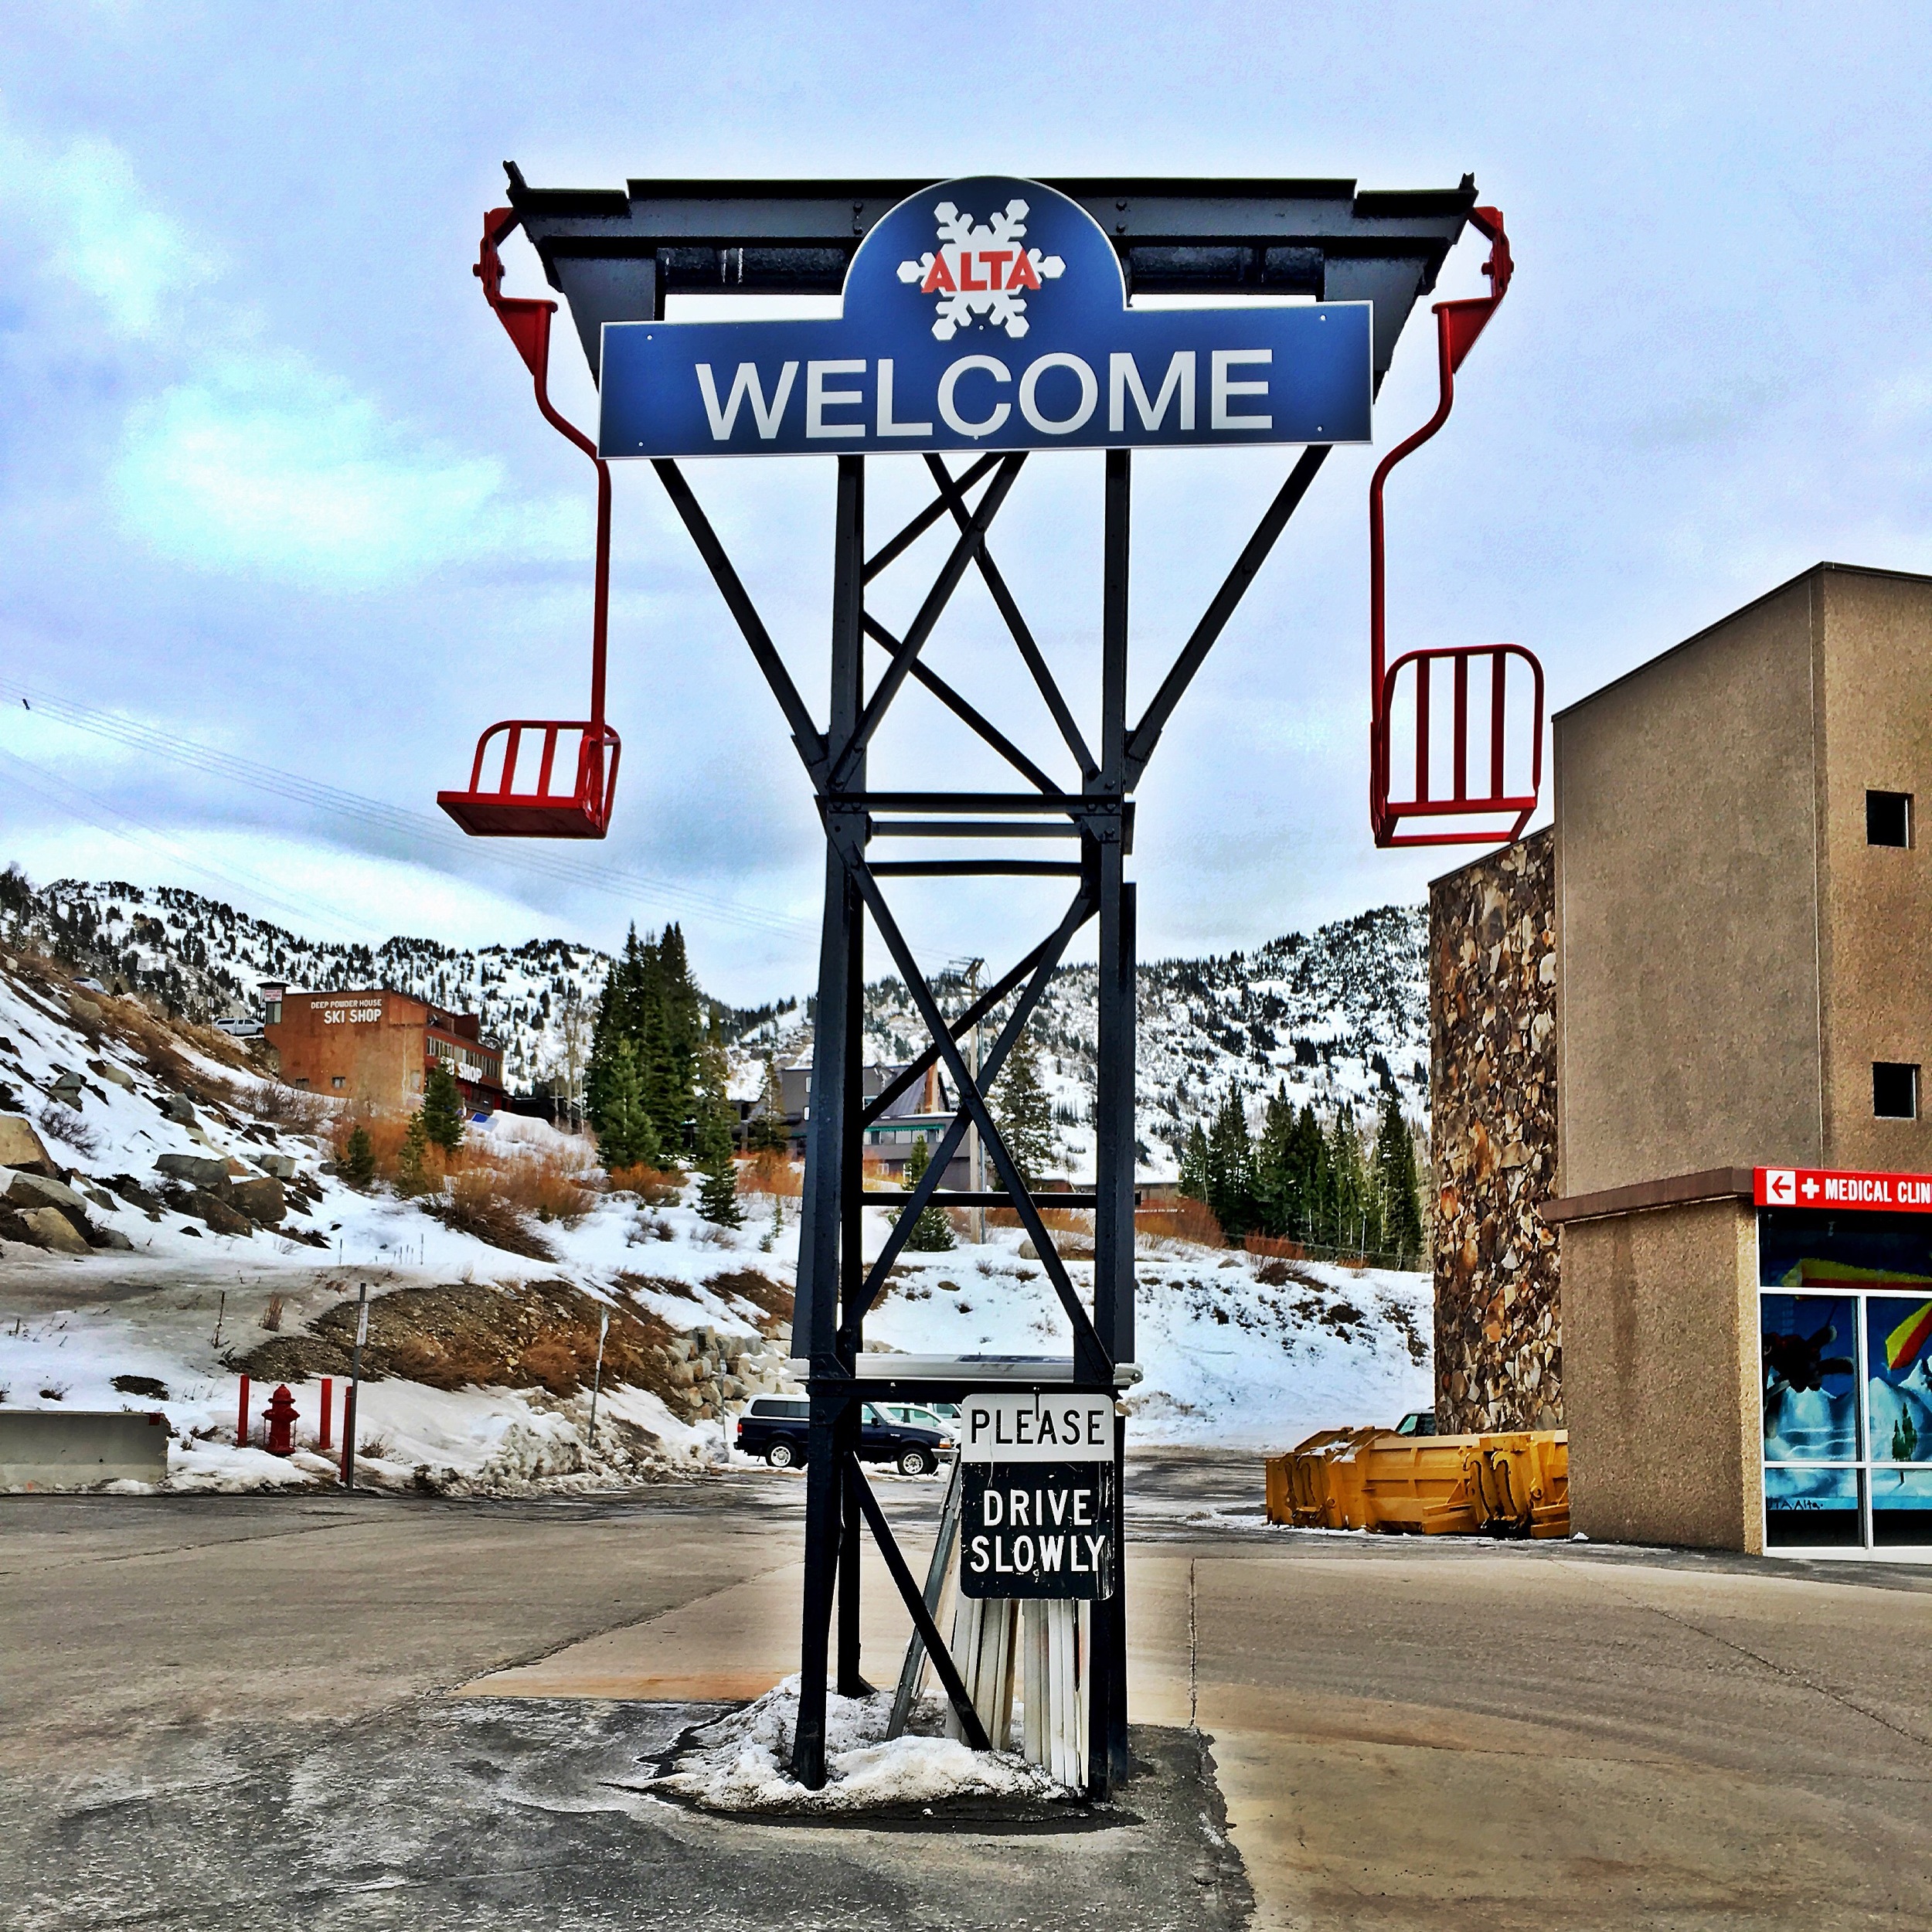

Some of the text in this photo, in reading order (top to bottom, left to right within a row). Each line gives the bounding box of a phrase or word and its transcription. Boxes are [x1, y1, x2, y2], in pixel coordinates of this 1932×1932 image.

[921, 248, 1042, 294] ALTA
[696, 349, 1273, 440] WELCOME
[324, 1009, 382, 1024] SKI SHOP
[457, 1062, 482, 1083] SHOP
[1825, 1179, 1932, 1204] MEDICAL CLIN
[971, 1410, 1105, 1445] PLEASE
[984, 1489, 1092, 1526] DRIVE
[971, 1535, 1106, 1573] SLOWLY
